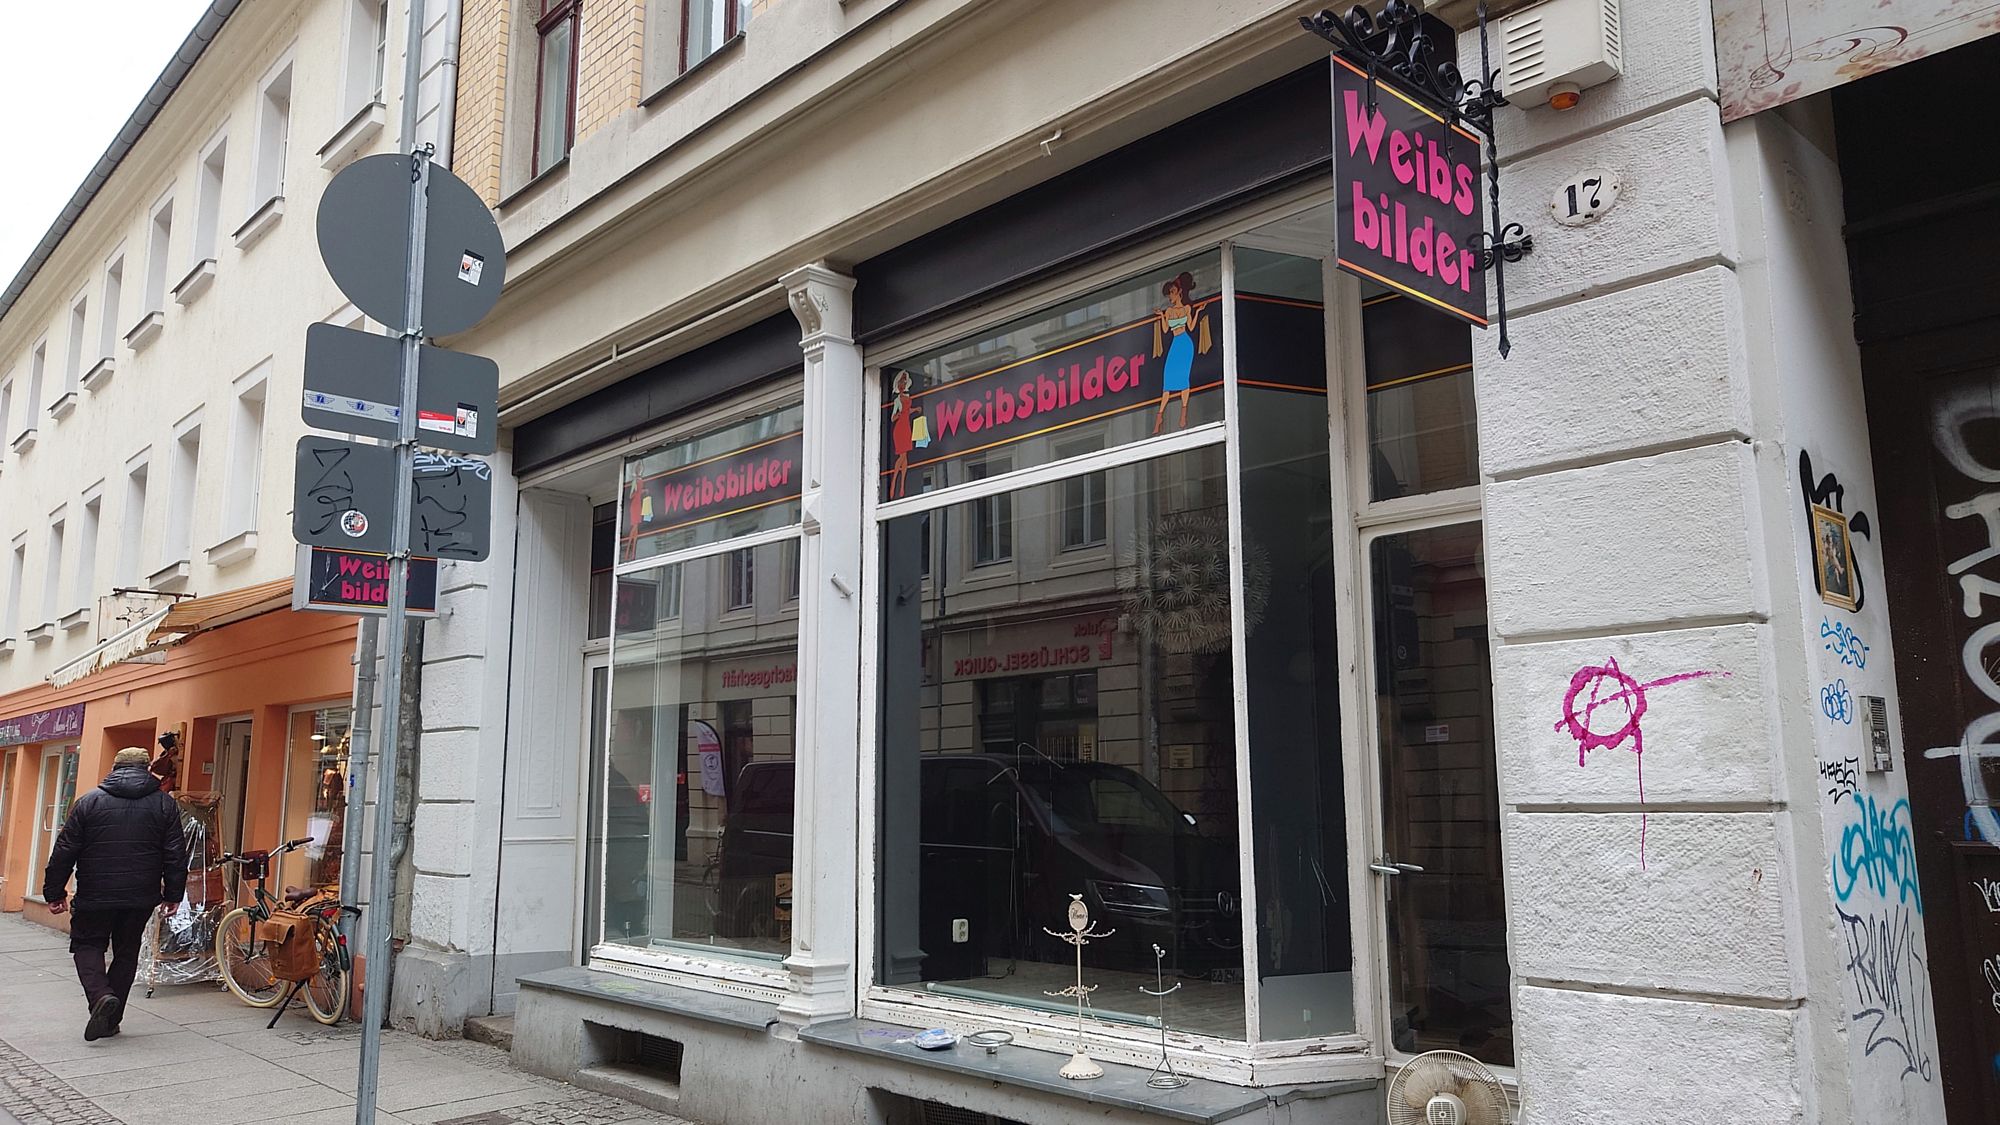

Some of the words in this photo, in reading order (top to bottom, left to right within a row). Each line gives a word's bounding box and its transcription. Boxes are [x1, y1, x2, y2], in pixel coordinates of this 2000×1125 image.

[1344, 89, 1474, 217] Weibs
[1564, 175, 1602, 218] 17
[1352, 180, 1476, 293] bilder
[935, 353, 1146, 442] Weibsbilder
[664, 457, 792, 515] Weibsbilder
[339, 555, 410, 581] Wei
[340, 580, 409, 603] bild
